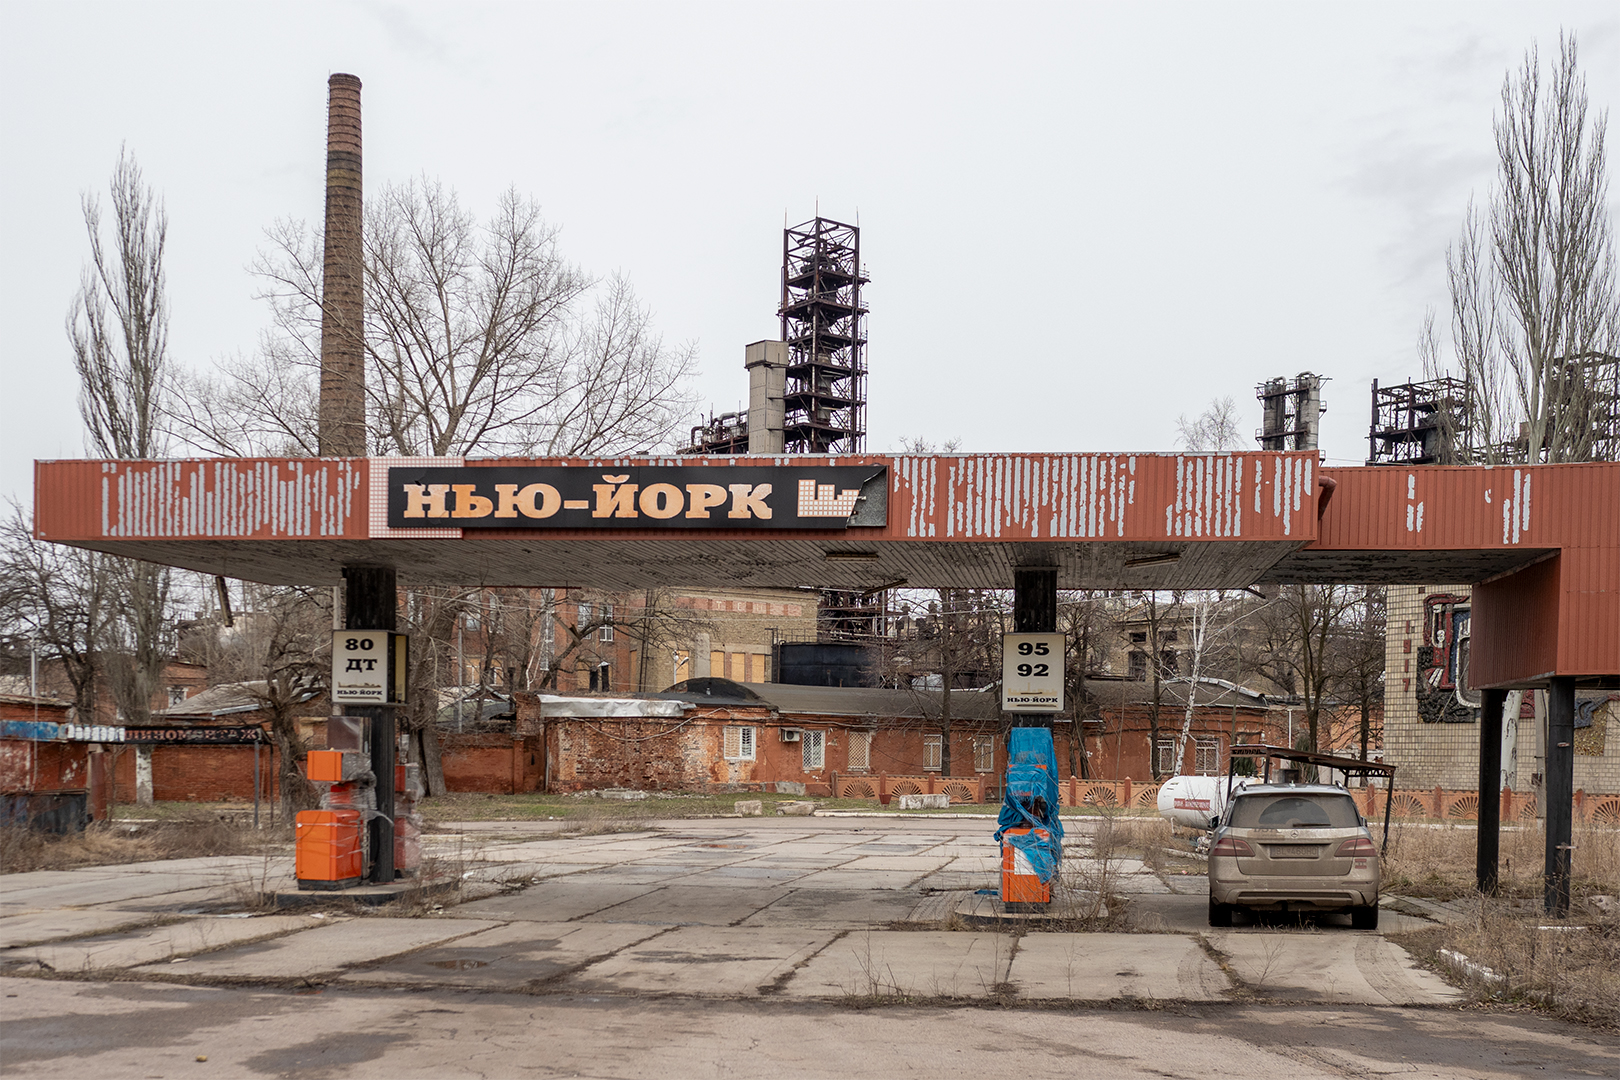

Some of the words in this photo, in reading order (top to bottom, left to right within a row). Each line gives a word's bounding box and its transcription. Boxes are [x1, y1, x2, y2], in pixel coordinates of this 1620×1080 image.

[402, 474, 774, 520] НЬЮ-ЙОРК
[345, 638, 374, 650] 80
[1017, 642, 1050, 656] 95
[1402, 619, 1411, 692] 1917
[345, 658, 378, 673] ДТ
[1016, 663, 1049, 677] 92
